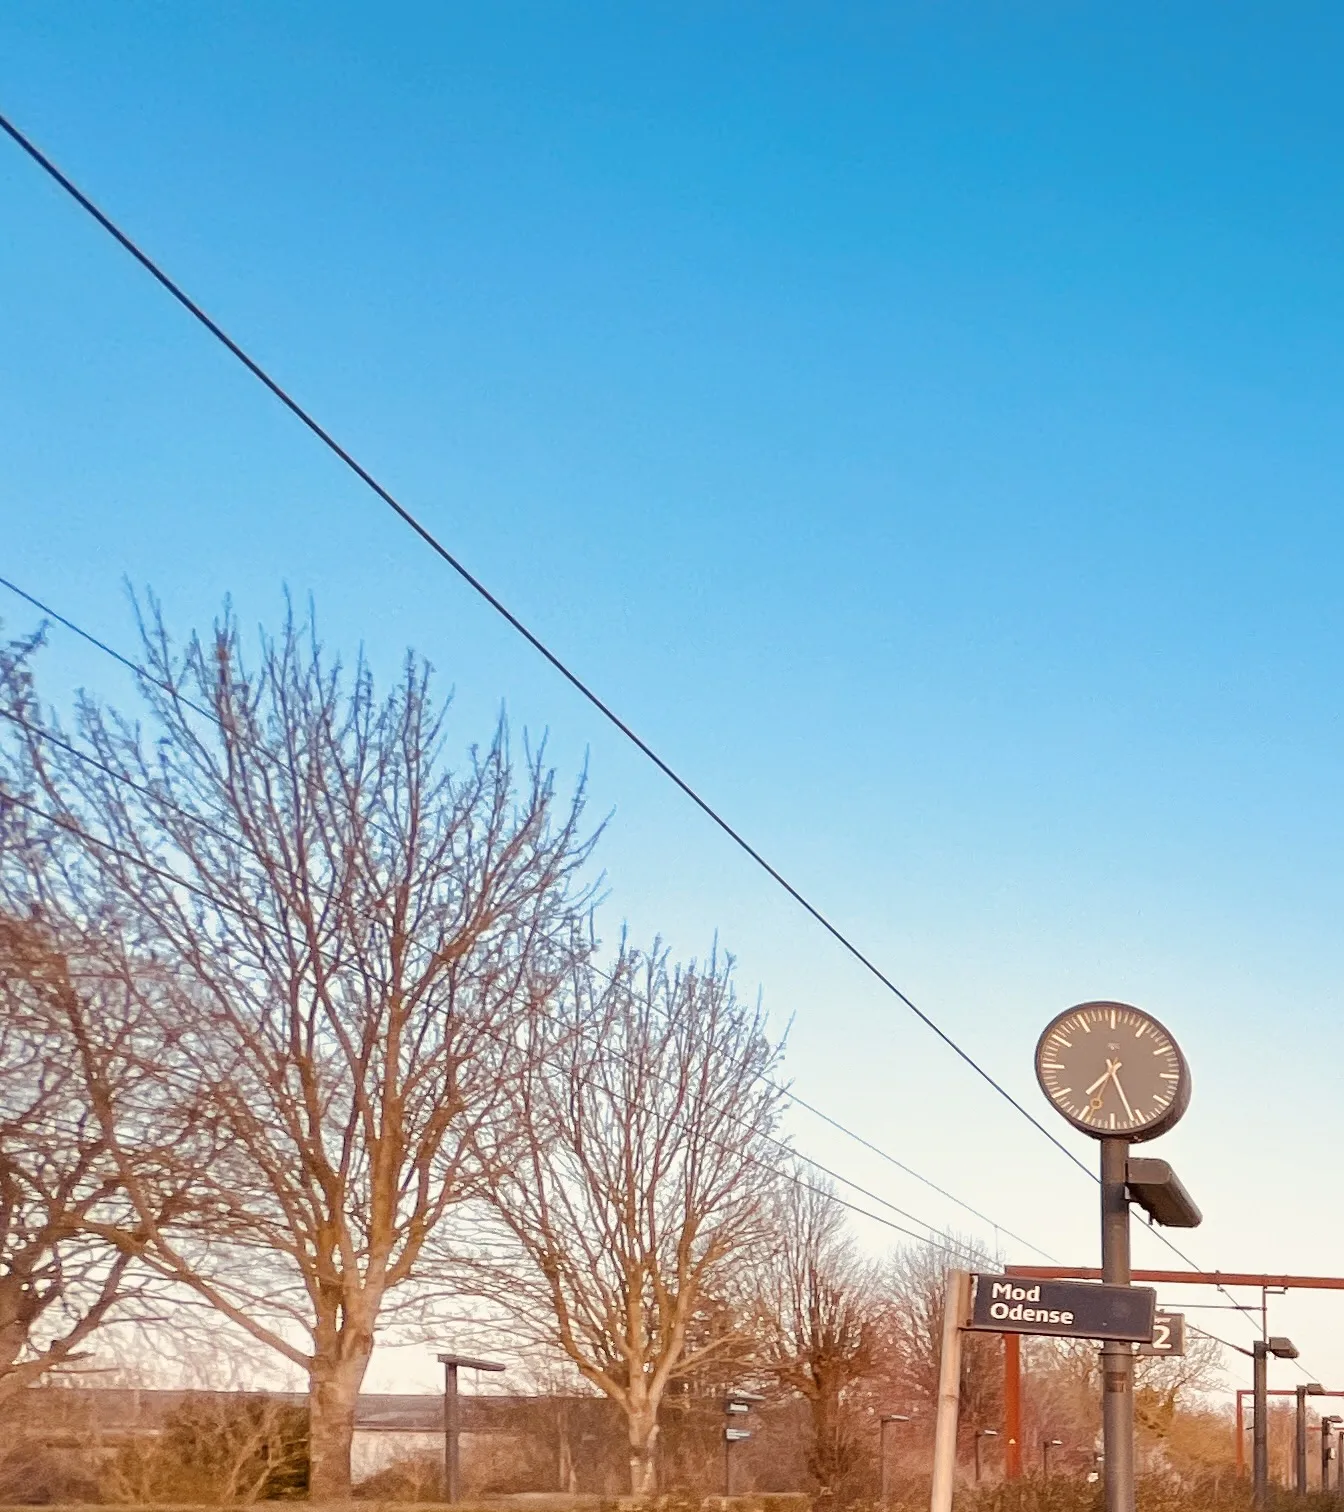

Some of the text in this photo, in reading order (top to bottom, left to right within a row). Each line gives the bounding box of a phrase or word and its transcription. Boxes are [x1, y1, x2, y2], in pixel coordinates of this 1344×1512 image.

[992, 1282, 1040, 1301] Mod
[990, 1302, 1074, 1325] Odense
[1152, 1325, 1172, 1349] 2
